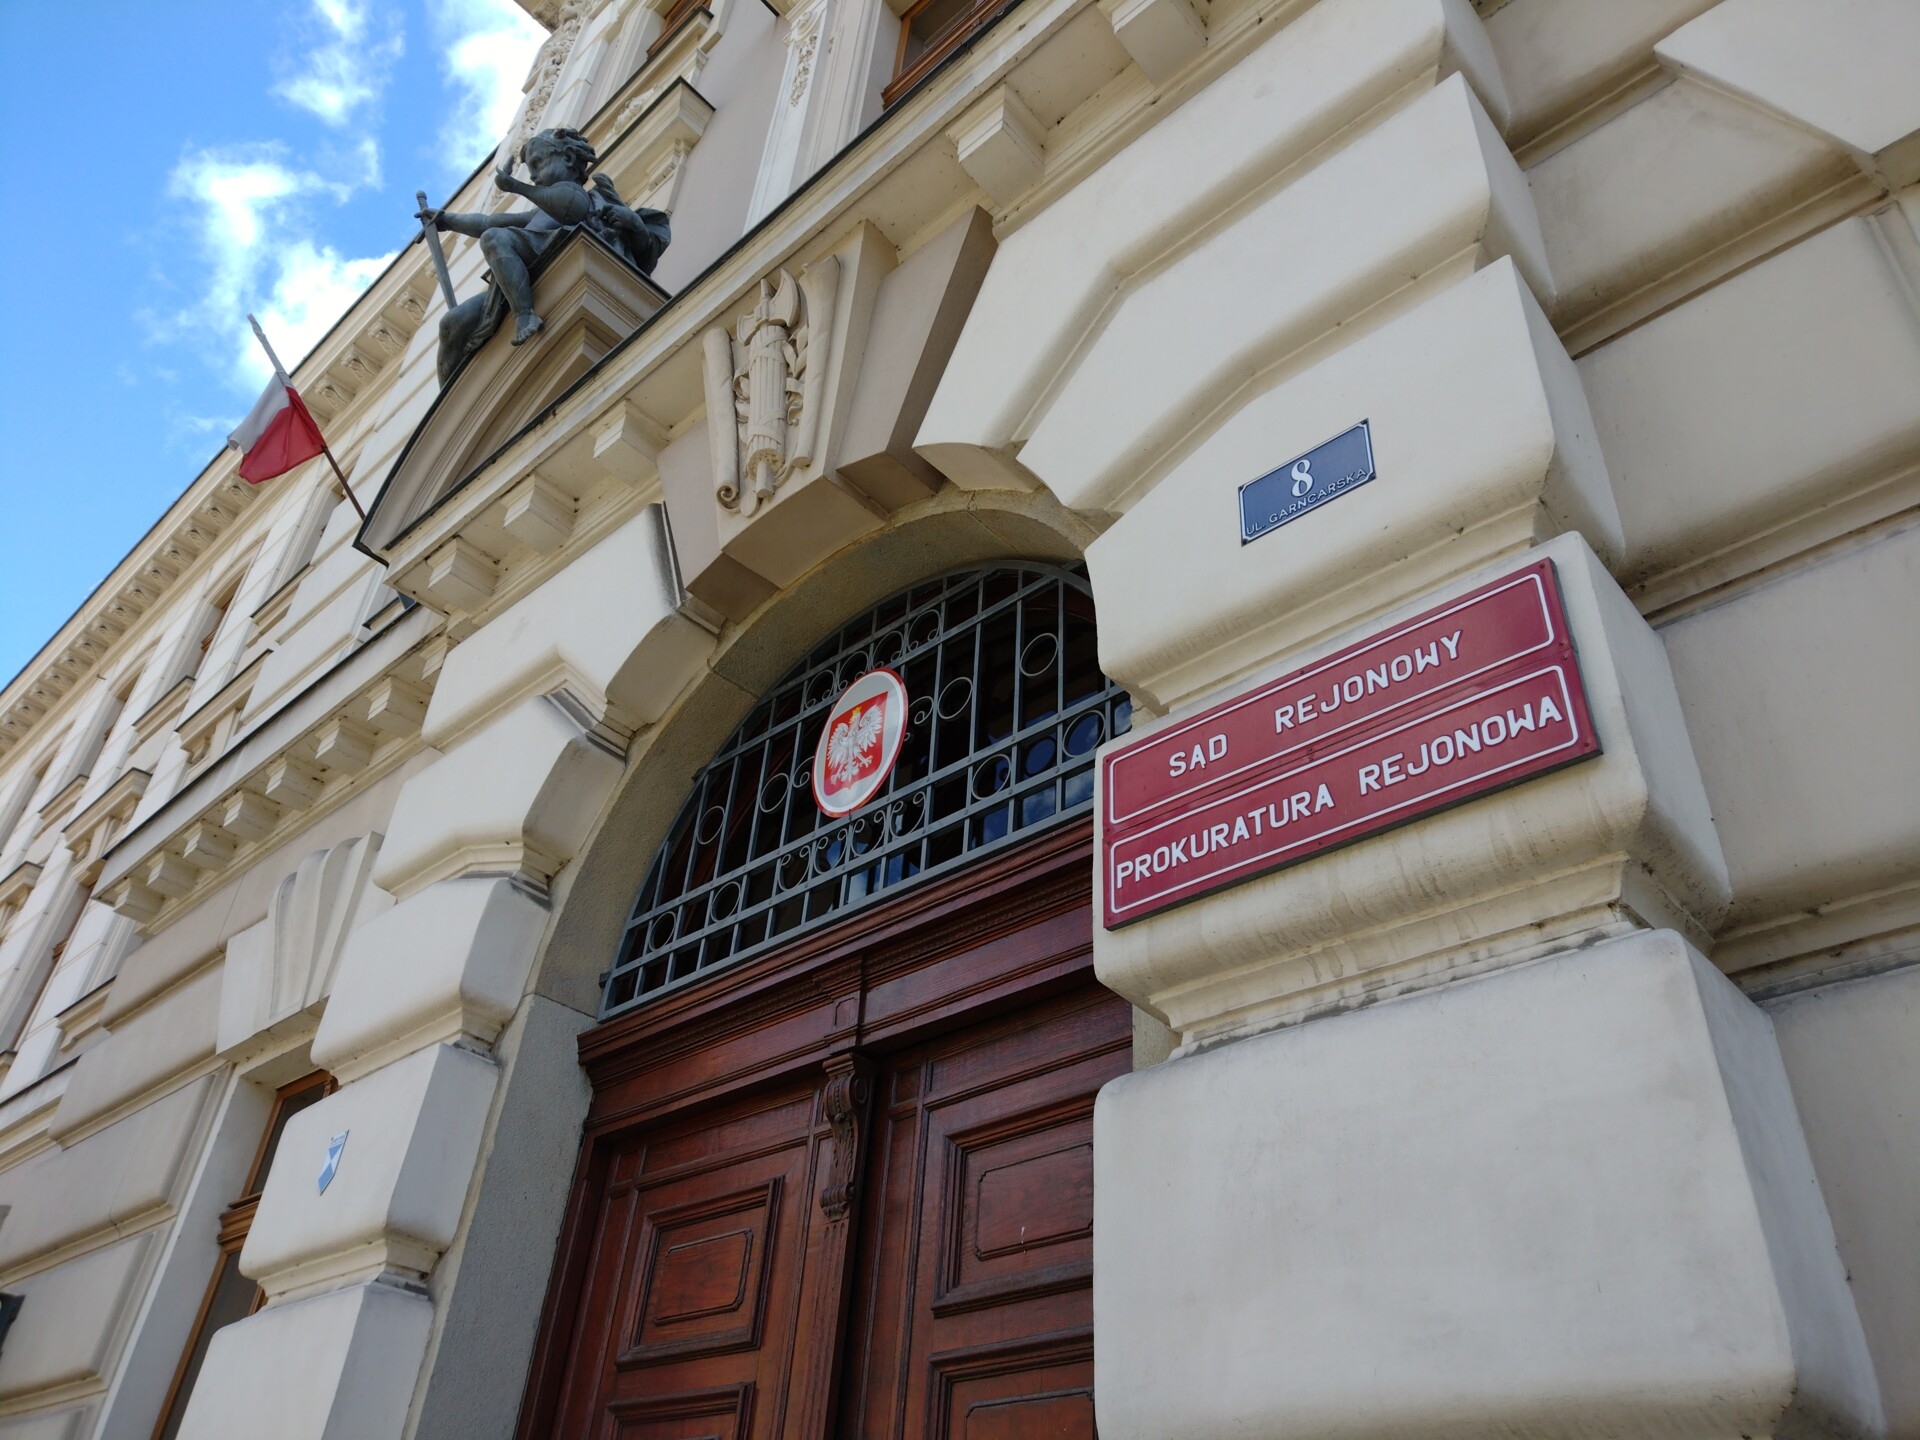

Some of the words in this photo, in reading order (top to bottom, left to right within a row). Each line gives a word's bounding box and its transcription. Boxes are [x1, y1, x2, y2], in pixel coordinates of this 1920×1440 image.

[1246, 522, 1266, 535] UL.
[1269, 468, 1367, 523] GARNCARSKA
[1291, 459, 1313, 497] 8
[1169, 733, 1228, 778] SĄD
[1274, 630, 1463, 733] REJONOWY
[1116, 783, 1335, 889] PROKURATURA
[1358, 696, 1563, 795] REJONOWA
